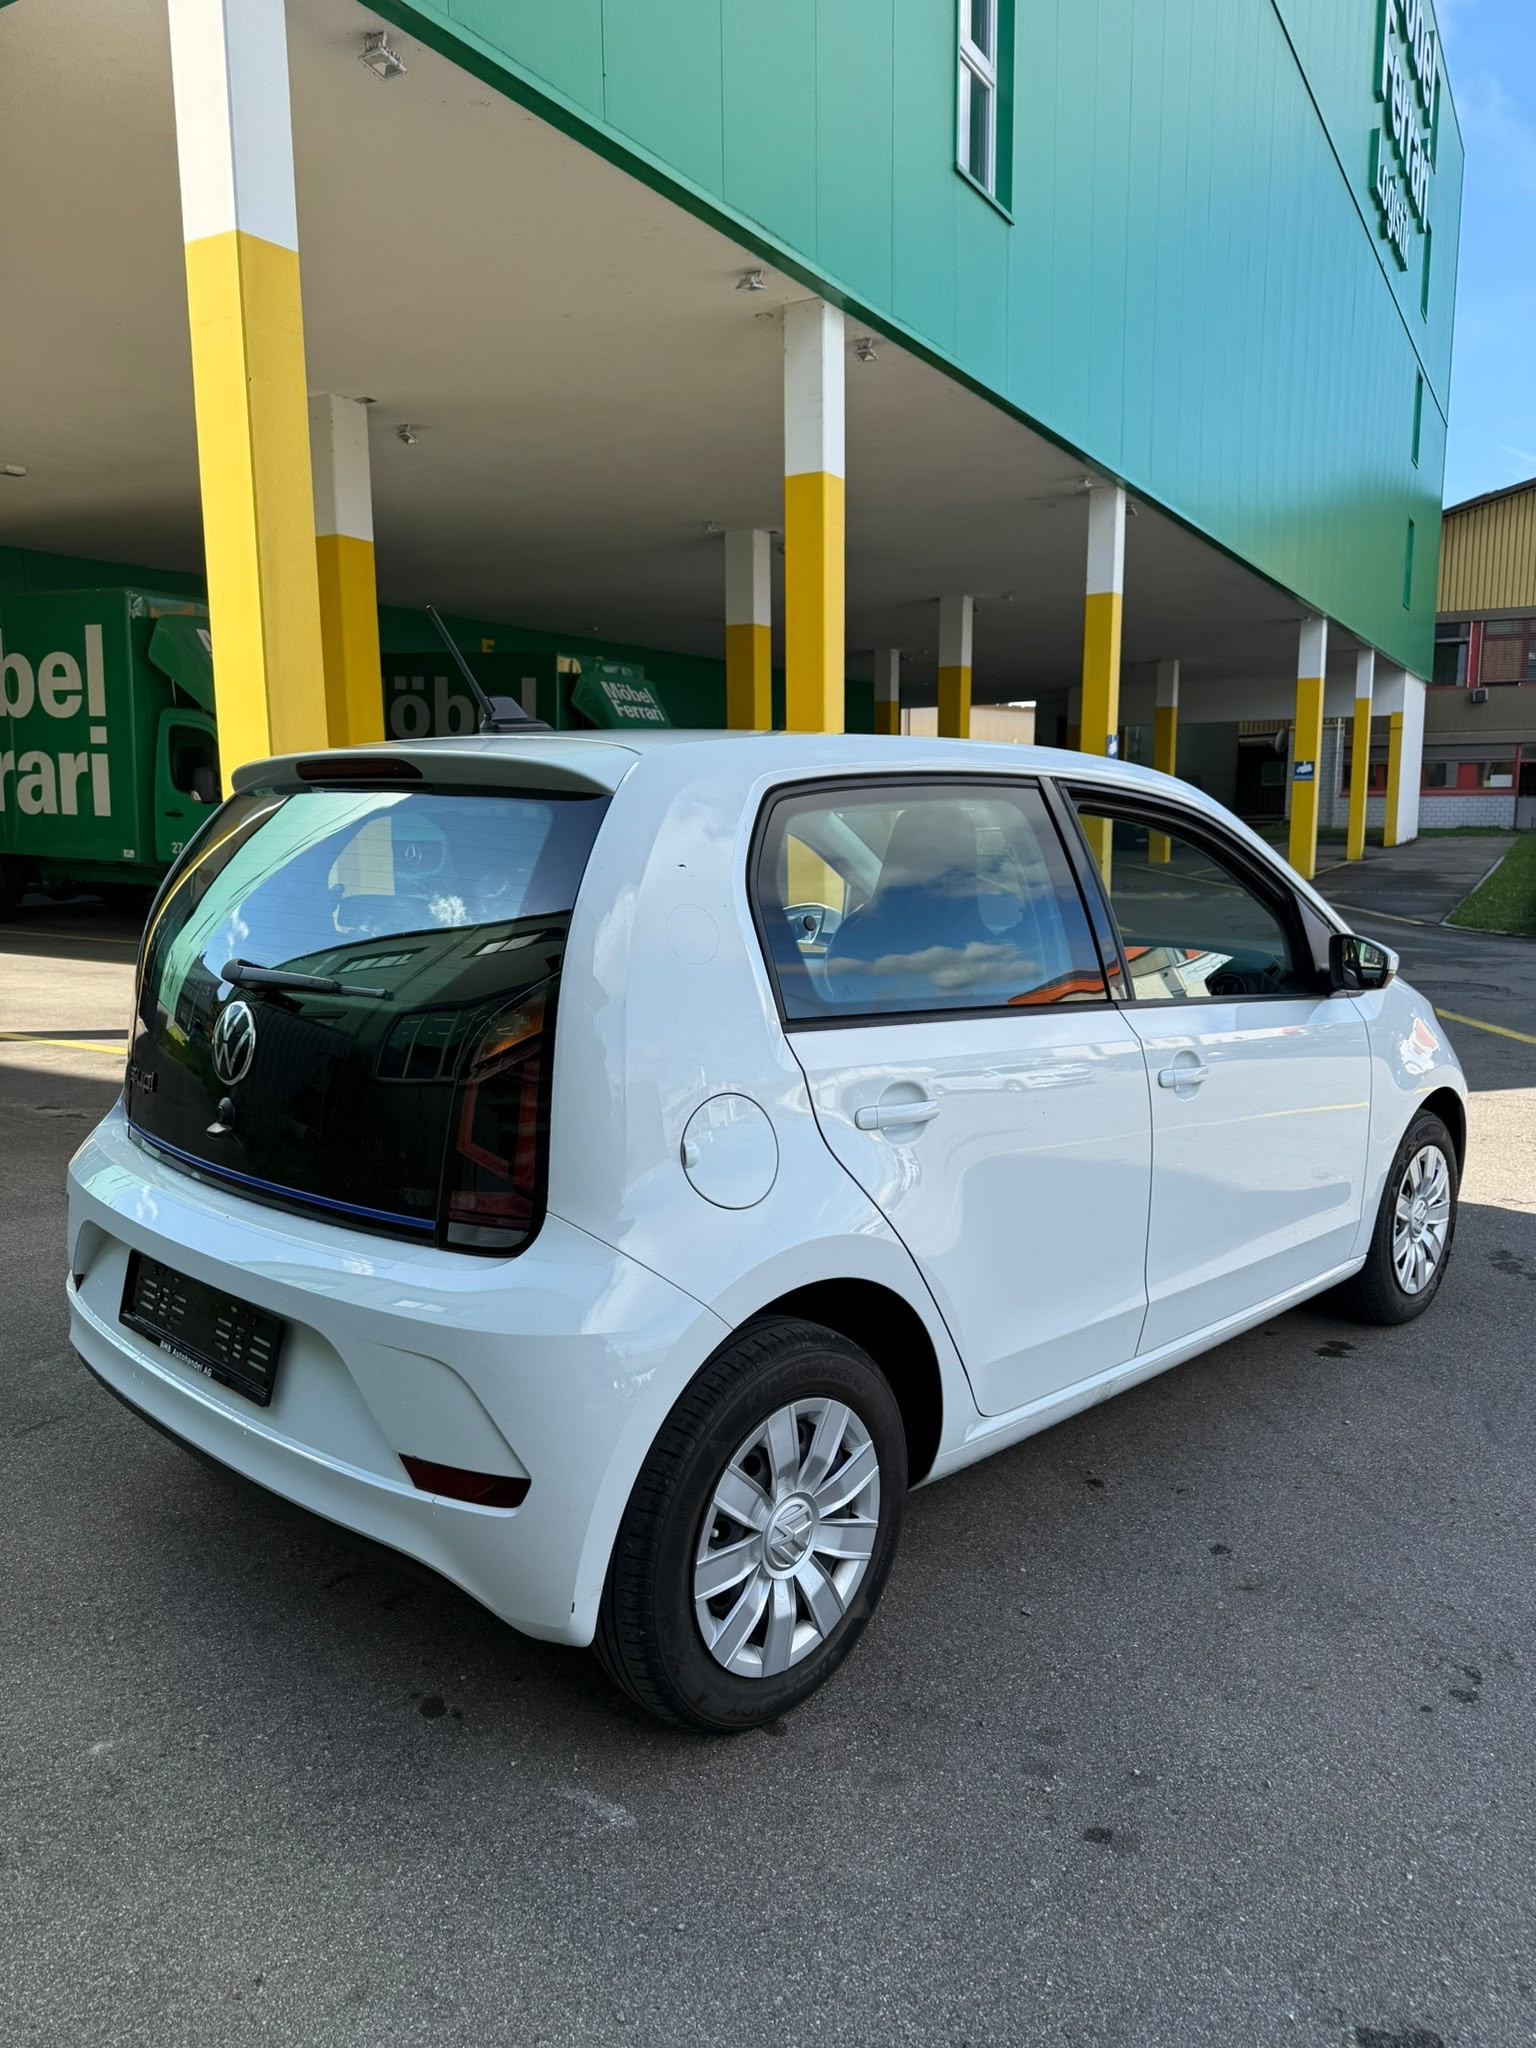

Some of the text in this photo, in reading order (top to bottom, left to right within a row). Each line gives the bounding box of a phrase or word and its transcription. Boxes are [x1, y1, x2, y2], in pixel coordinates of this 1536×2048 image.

[600, 681, 655, 704] Möbel
[383, 676, 537, 738] öbl
[611, 699, 665, 722] Ferrari
[172, 1348, 203, 1372] Autohandel
[203, 1366, 213, 1377] AG
